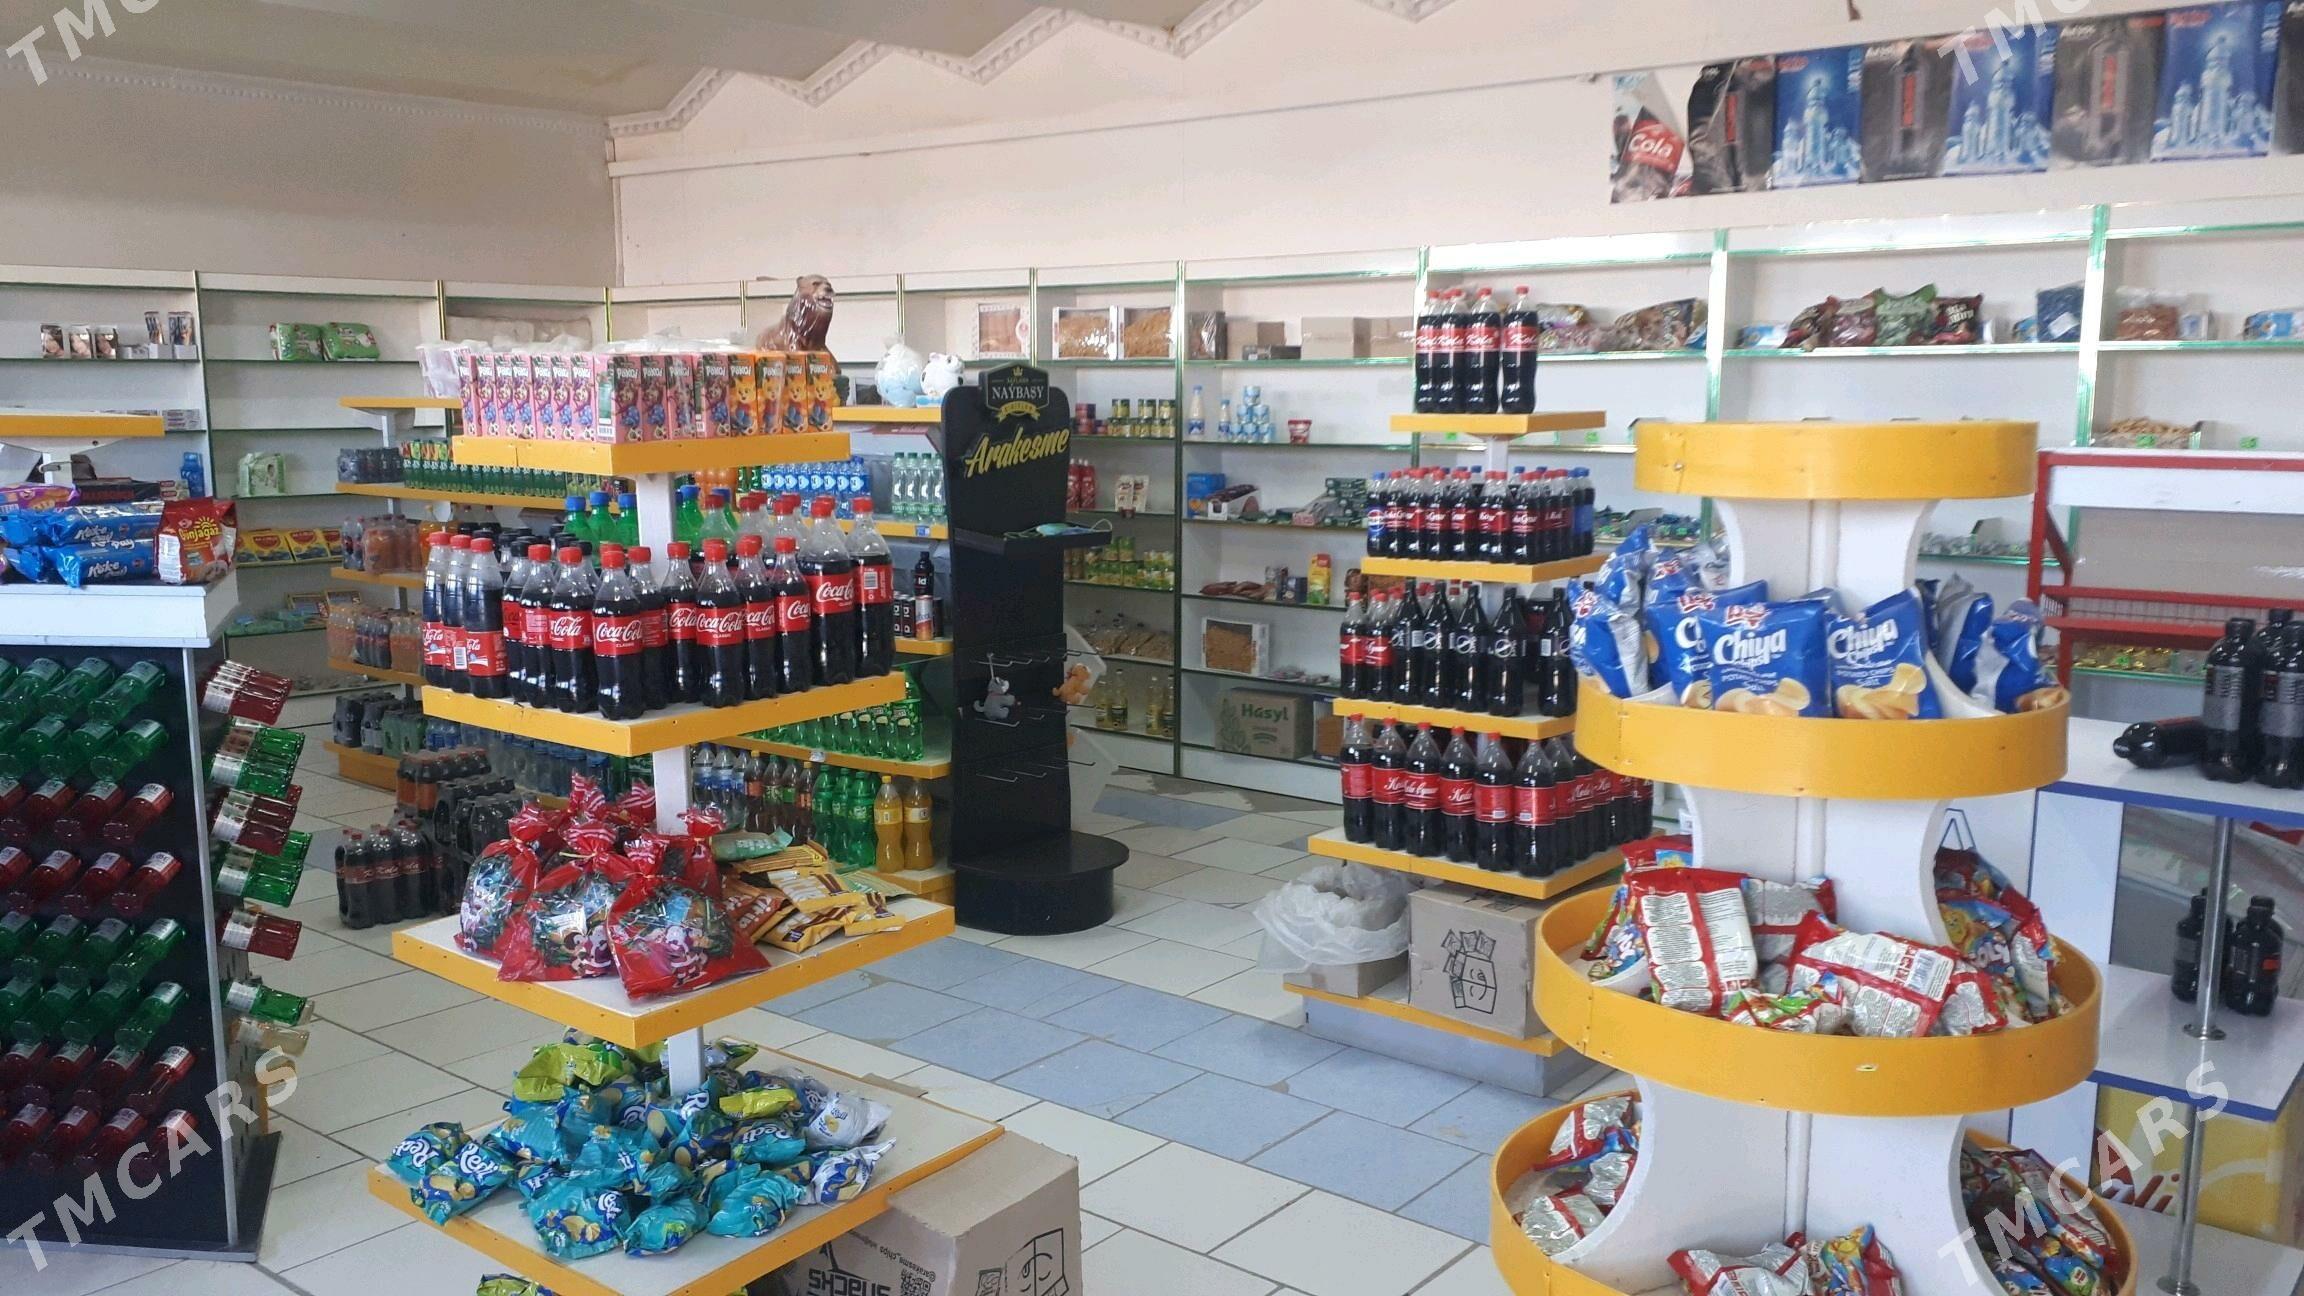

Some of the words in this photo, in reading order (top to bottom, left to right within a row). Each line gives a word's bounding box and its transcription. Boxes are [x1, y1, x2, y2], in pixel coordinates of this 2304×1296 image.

[1628, 133, 1673, 158] Cola
[965, 426, 1070, 478] Arakesme
[1713, 628, 1787, 666] Chiya
[1827, 617, 1899, 661] Chiya
